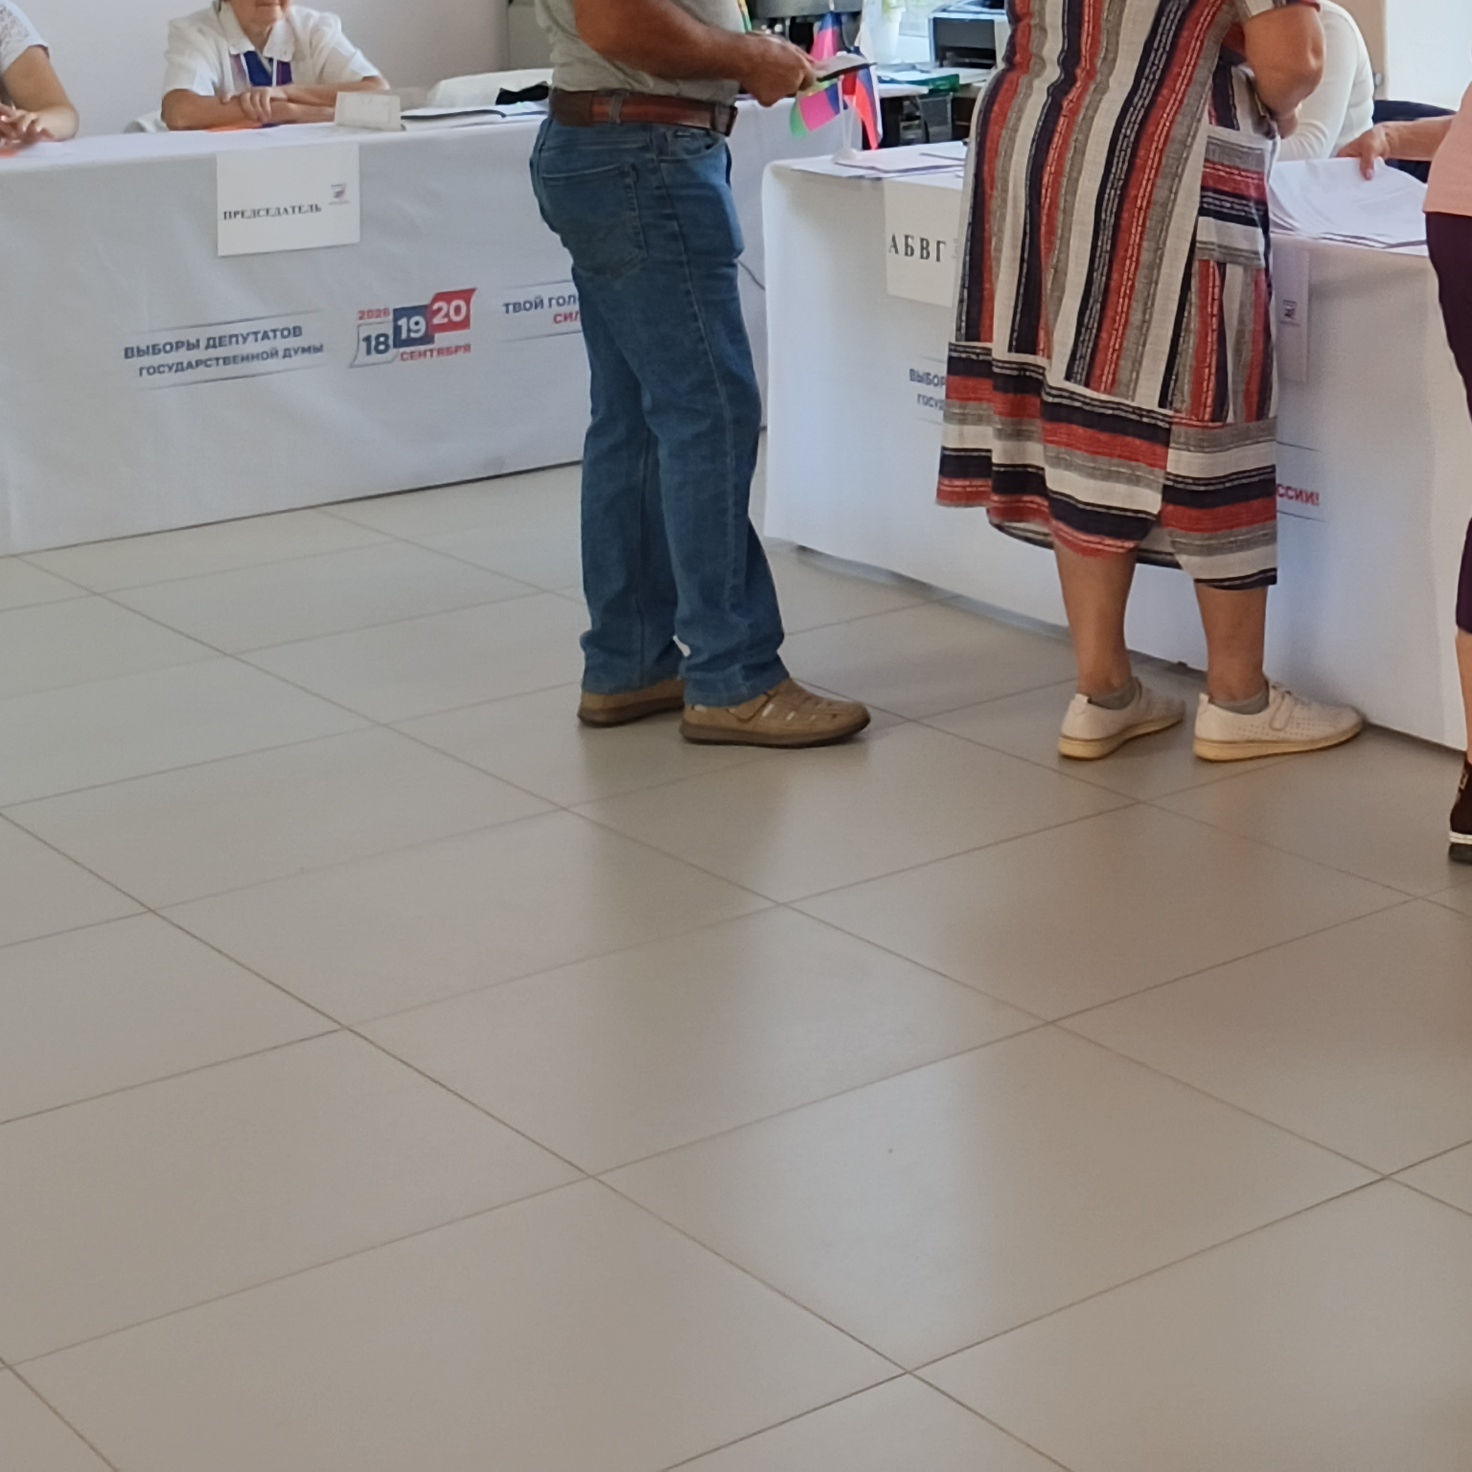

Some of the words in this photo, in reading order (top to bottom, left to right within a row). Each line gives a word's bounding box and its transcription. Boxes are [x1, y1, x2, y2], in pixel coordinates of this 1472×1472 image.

[223, 203, 322, 220] ПРЕДСЕДАТЕЛЬ
[503, 295, 544, 315] ТВОЙ
[547, 294, 577, 309] ГОЛ
[362, 333, 390, 356] 18
[397, 315, 426, 339] 19
[432, 299, 467, 324] 20
[123, 339, 200, 360] ВЫБОРЫ
[204, 325, 303, 351] ДЕПУТАТОВ
[400, 344, 472, 362] СЕНТЯБРЯ
[138, 347, 279, 377] ГОСУДАРСТВЕННОЙ
[282, 344, 324, 359] ДУМЫ
